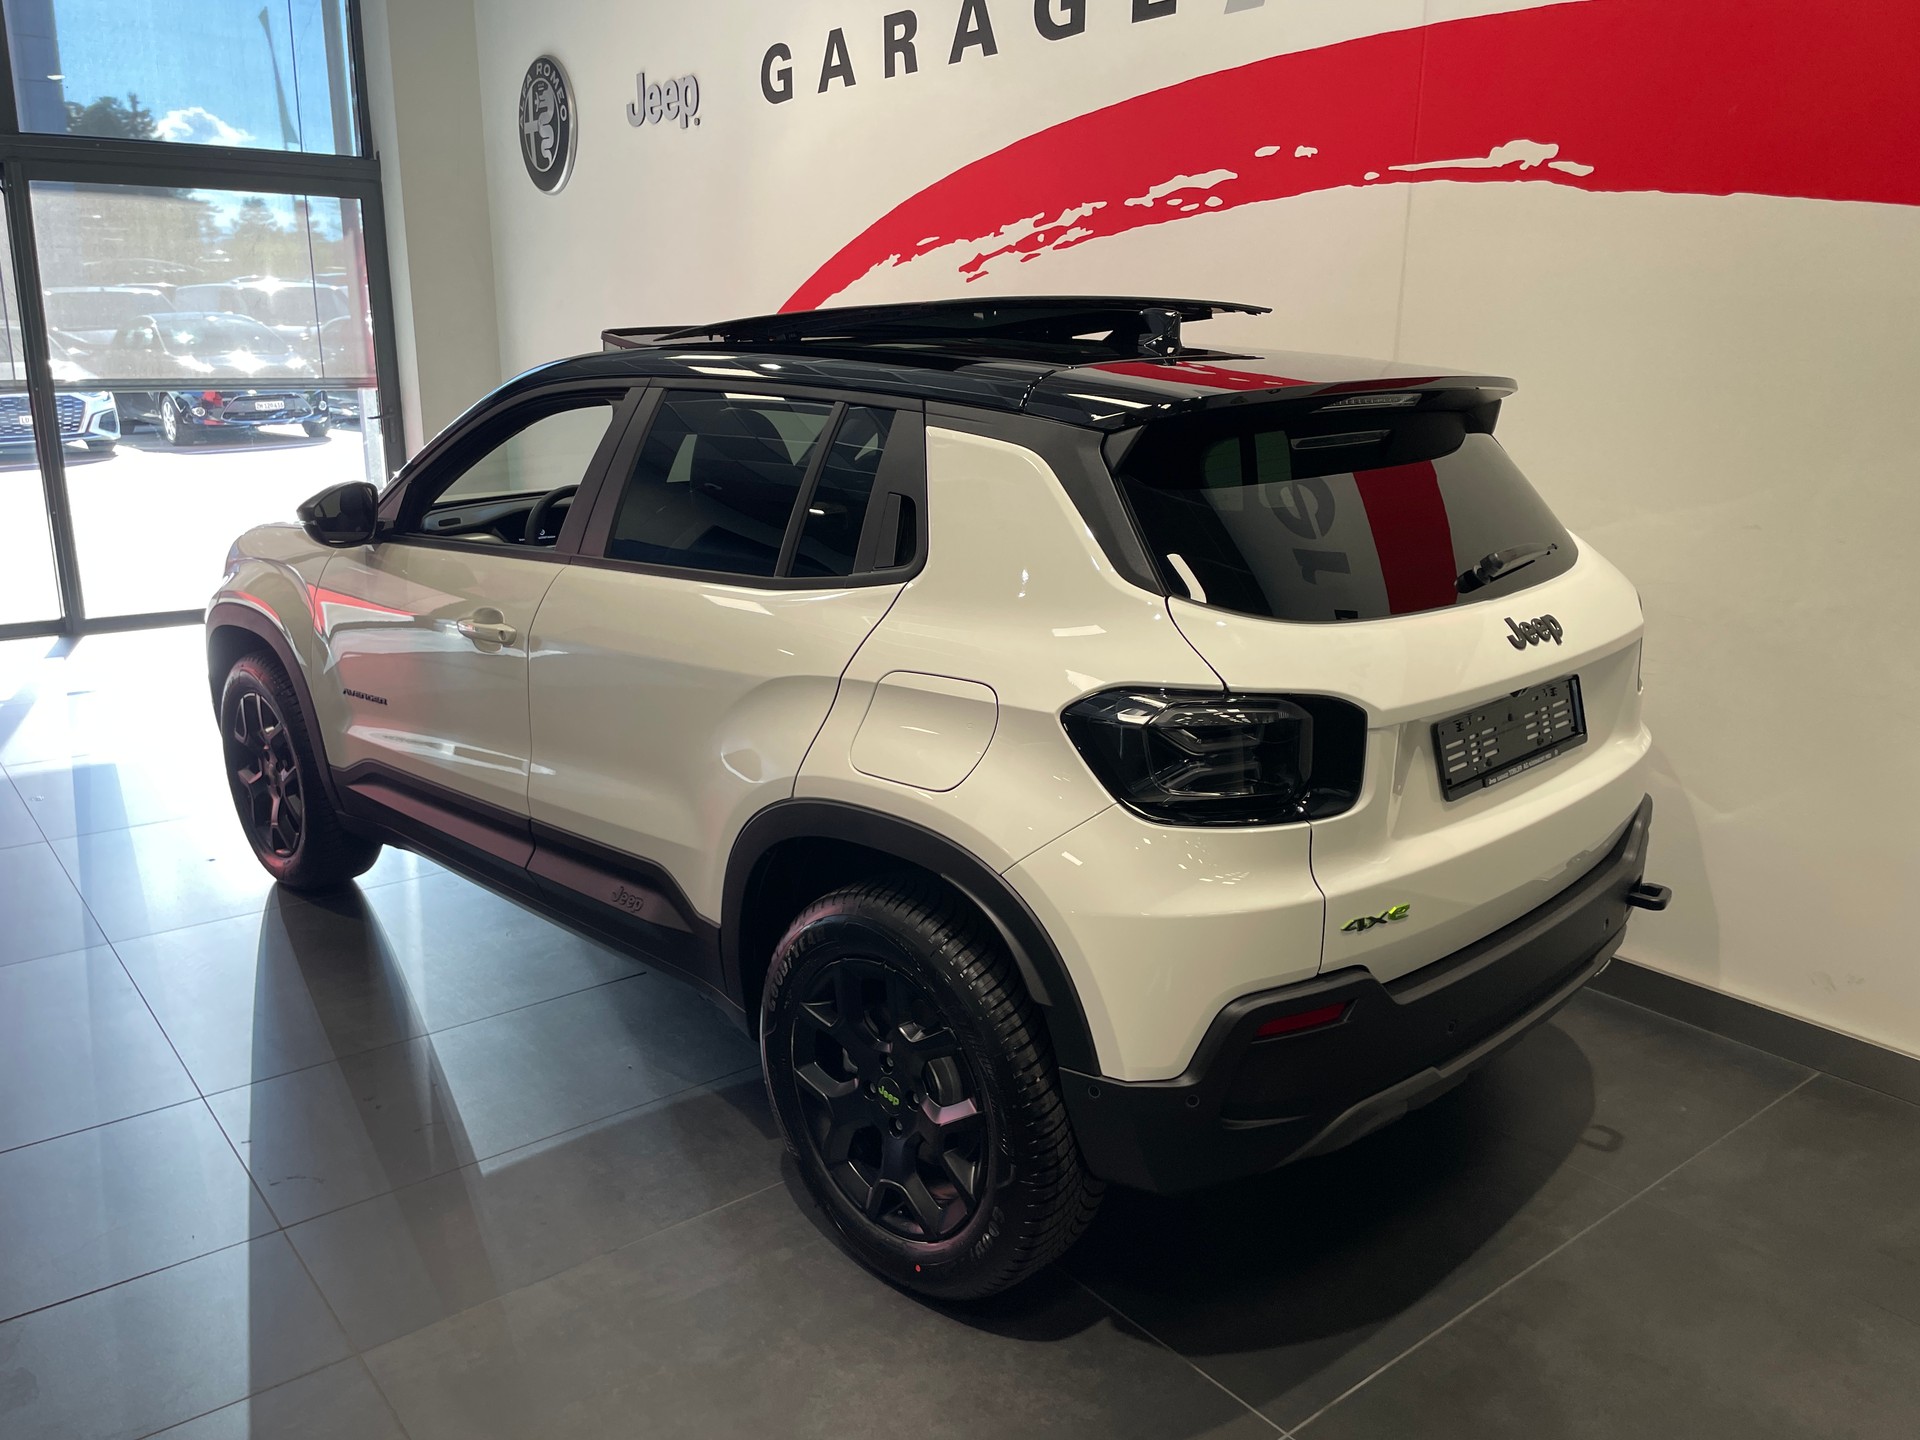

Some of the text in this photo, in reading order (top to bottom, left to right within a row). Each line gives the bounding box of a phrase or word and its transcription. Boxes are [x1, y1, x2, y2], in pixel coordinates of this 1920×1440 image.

[761, 0, 1177, 104] GARAG
[519, 62, 568, 129] ALFA ROMEO
[626, 72, 700, 129] Jeep
[1504, 614, 1563, 651] Jeep
[611, 885, 644, 913] Jeep
[878, 1085, 900, 1106] Jeep
